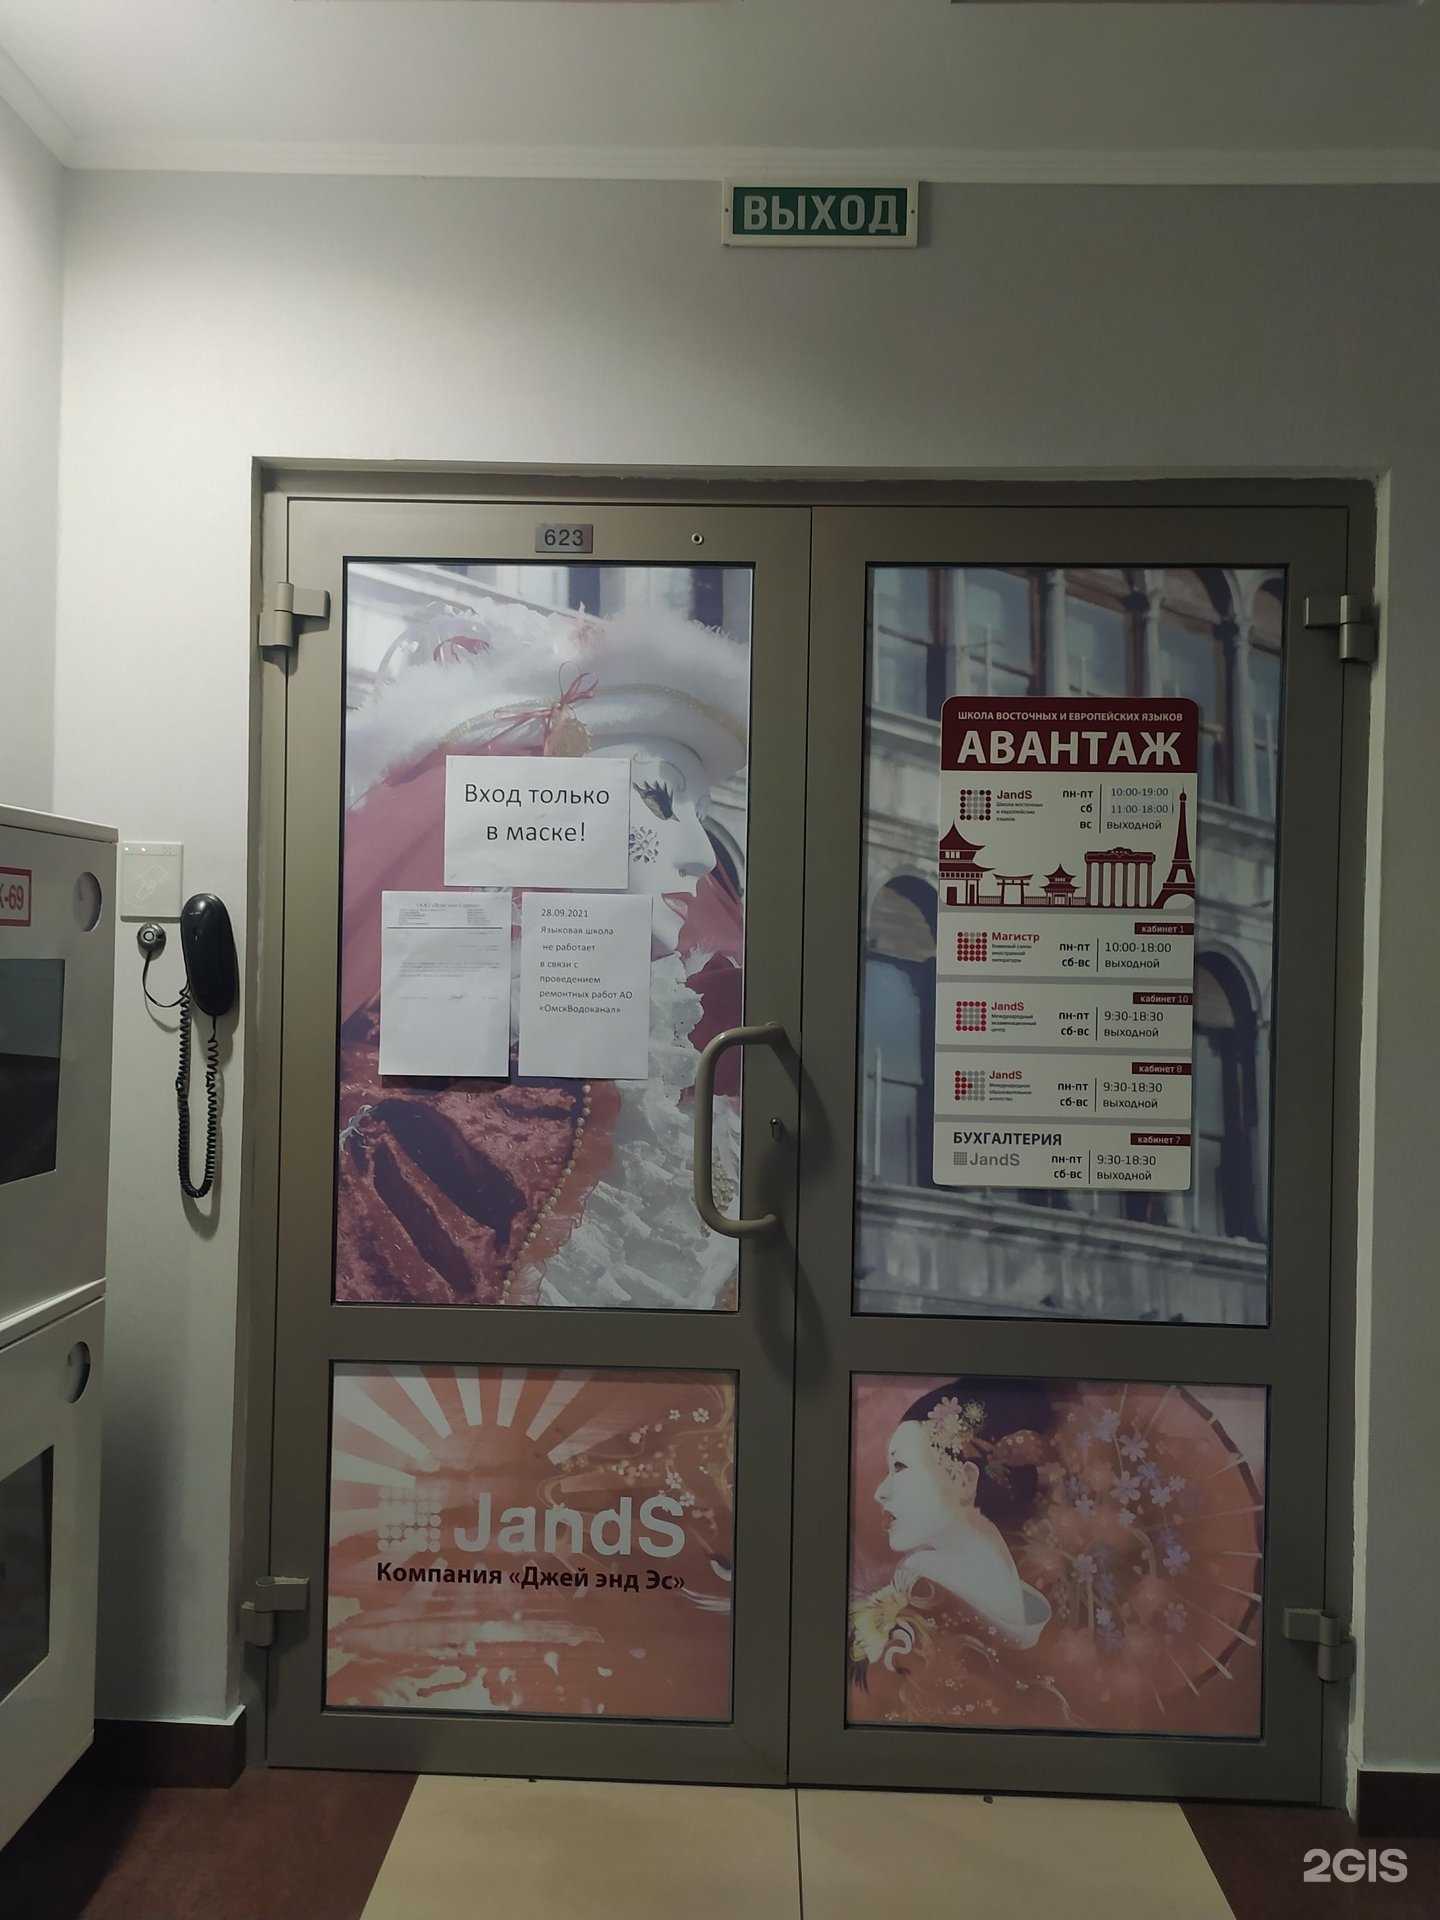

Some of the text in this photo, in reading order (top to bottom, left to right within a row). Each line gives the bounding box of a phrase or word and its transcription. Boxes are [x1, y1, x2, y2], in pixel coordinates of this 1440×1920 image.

[743, 195, 898, 233] ВЫХОД
[544, 529, 584, 546] 623
[958, 710, 1183, 722] ШКОЛА ВОСТОЧНЫХ И ЕВРОПЕЙСКИХ ЯЗЫКОВ
[957, 730, 1182, 766] АВАНТАЖ
[464, 783, 610, 807] Вход только
[996, 789, 1033, 800] JandS
[1062, 787, 1169, 799] пн-пт 10:00-19:00
[1080, 803, 1169, 814] сб 11:00-18:00
[1079, 819, 1162, 831] вс выходной
[486, 822, 586, 842] в маске!
[541, 908, 588, 918] 28.09.2021
[540, 926, 614, 936] Языковая школа
[1141, 924, 1185, 934] кабинет 1
[991, 931, 1040, 944] Магистр
[555, 943, 596, 952] работает
[1059, 942, 1171, 953] пн-пт 10:00-18:00
[547, 960, 572, 968] связи
[1061, 957, 1160, 969] сб-вс выходной
[539, 975, 601, 984] проведением
[539, 990, 633, 999] ремонтных работ АО
[1140, 994, 1189, 1004] кабинет 10
[991, 1001, 1025, 1012] JandS
[1058, 1011, 1164, 1022] пн-пт 9:30-18:30
[1060, 1026, 1159, 1038] сб-вс выходной
[1138, 1064, 1173, 1074] кабинет
[989, 1070, 1023, 1081] JandS
[1058, 1081, 1163, 1093] пн-пт 9:30-18:30
[1059, 1096, 1158, 1109] сб-вс выходной
[953, 1132, 1062, 1146] БУХГАЛТЕРИЯ
[1137, 1135, 1174, 1145] кабинет
[969, 1152, 1021, 1167] JandS
[1051, 1153, 1156, 1166] пн-пт 9:30-18:30
[1053, 1169, 1152, 1181] сб-вс выходной
[454, 1492, 686, 1559] JandS
[377, 1562, 686, 1592] Компания «Джей энд Эс»
